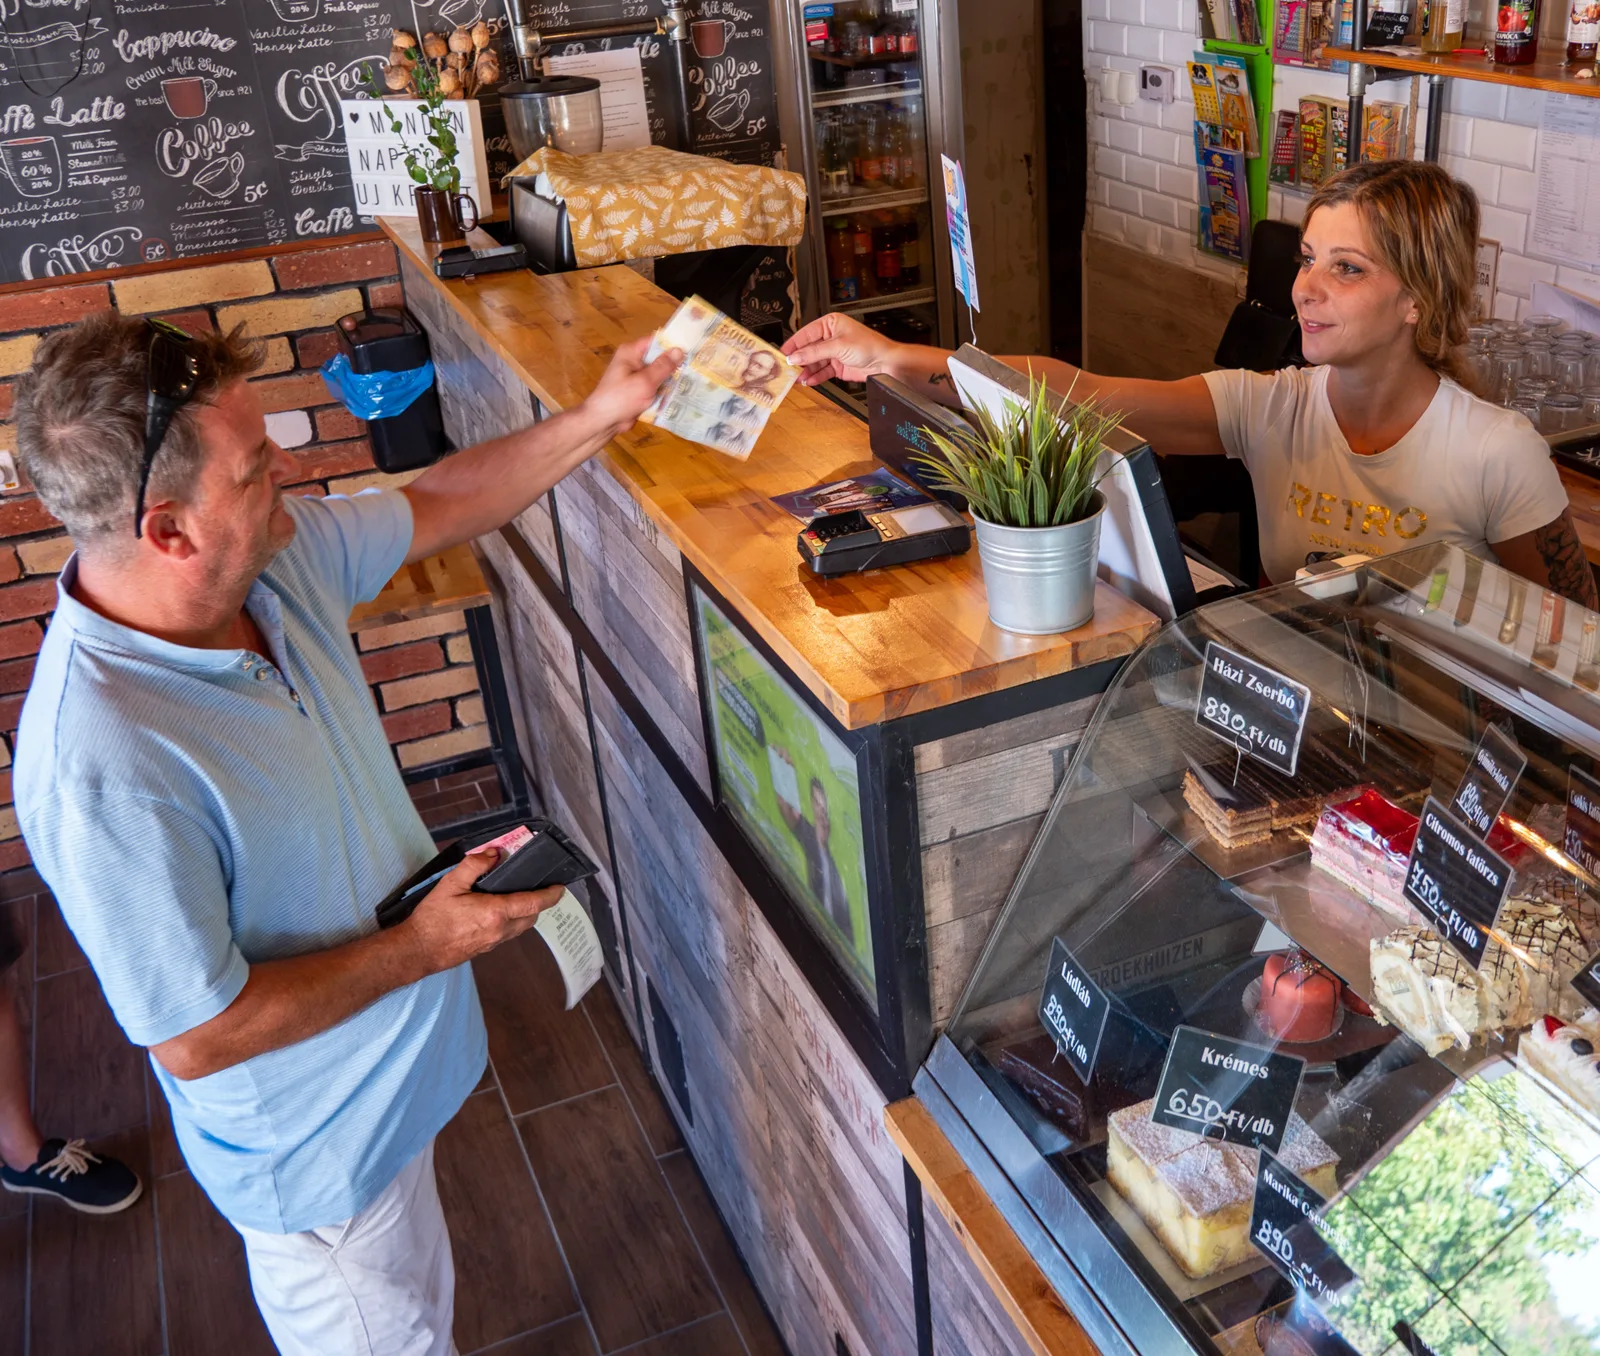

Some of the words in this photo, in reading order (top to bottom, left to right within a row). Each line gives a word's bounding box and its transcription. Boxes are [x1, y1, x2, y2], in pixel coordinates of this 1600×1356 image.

[290, 5, 310, 14] 20%
[324, 3, 346, 14] Fresh
[347, 2, 380, 13] Espresso
[529, 2, 571, 17] Single
[721, 1, 753, 21] Sugar
[250, 26, 299, 39] Vanilla
[299, 23, 336, 34] Latte
[363, 13, 392, 28] $3.00
[530, 16, 571, 29] Double
[112, 27, 237, 63] Cappucino
[253, 42, 296, 53] Honey
[297, 38, 334, 49] Latte
[365, 27, 394, 41] $3.00
[126, 65, 166, 90] Cream
[167, 56, 196, 75] Milk
[198, 57, 237, 78] Sugar
[135, 98, 148, 106] the
[217, 89, 235, 97] since
[237, 86, 253, 95] 1921
[277, 55, 391, 141] Coffee
[43, 95, 126, 127] Latte
[746, 116, 767, 136] 5¢
[21, 150, 42, 159] 20%
[95, 137, 119, 148] Foam
[155, 117, 255, 177] Coffee
[21, 164, 53, 178] 60%
[67, 177, 92, 188] Fresh
[92, 174, 128, 186] Espresso
[290, 167, 333, 183] Single
[31, 180, 53, 189] 20%
[244, 181, 269, 203] 5¢
[291, 181, 334, 196] Double
[43, 197, 82, 209] Latte
[110, 185, 141, 200] $3.00
[185, 199, 213, 210] little
[41, 211, 80, 223] Latte
[114, 198, 145, 213] $3.00
[294, 206, 354, 236] Caffè
[170, 218, 228, 232] Espresso
[1286, 481, 1428, 540] RETRO
[1212, 657, 1244, 684] Házi
[1246, 674, 1295, 710] Zserbó
[1249, 725, 1287, 756] Ft/db
[1425, 812, 1466, 857] Citromos
[1466, 849, 1499, 887] fatörzs
[1449, 909, 1478, 948] Ft/db
[1060, 962, 1091, 1009] Lúdláb
[1201, 1047, 1269, 1079] Krémes
[1227, 1110, 1275, 1136] Ft/db
[1263, 1169, 1299, 1209] Marika
